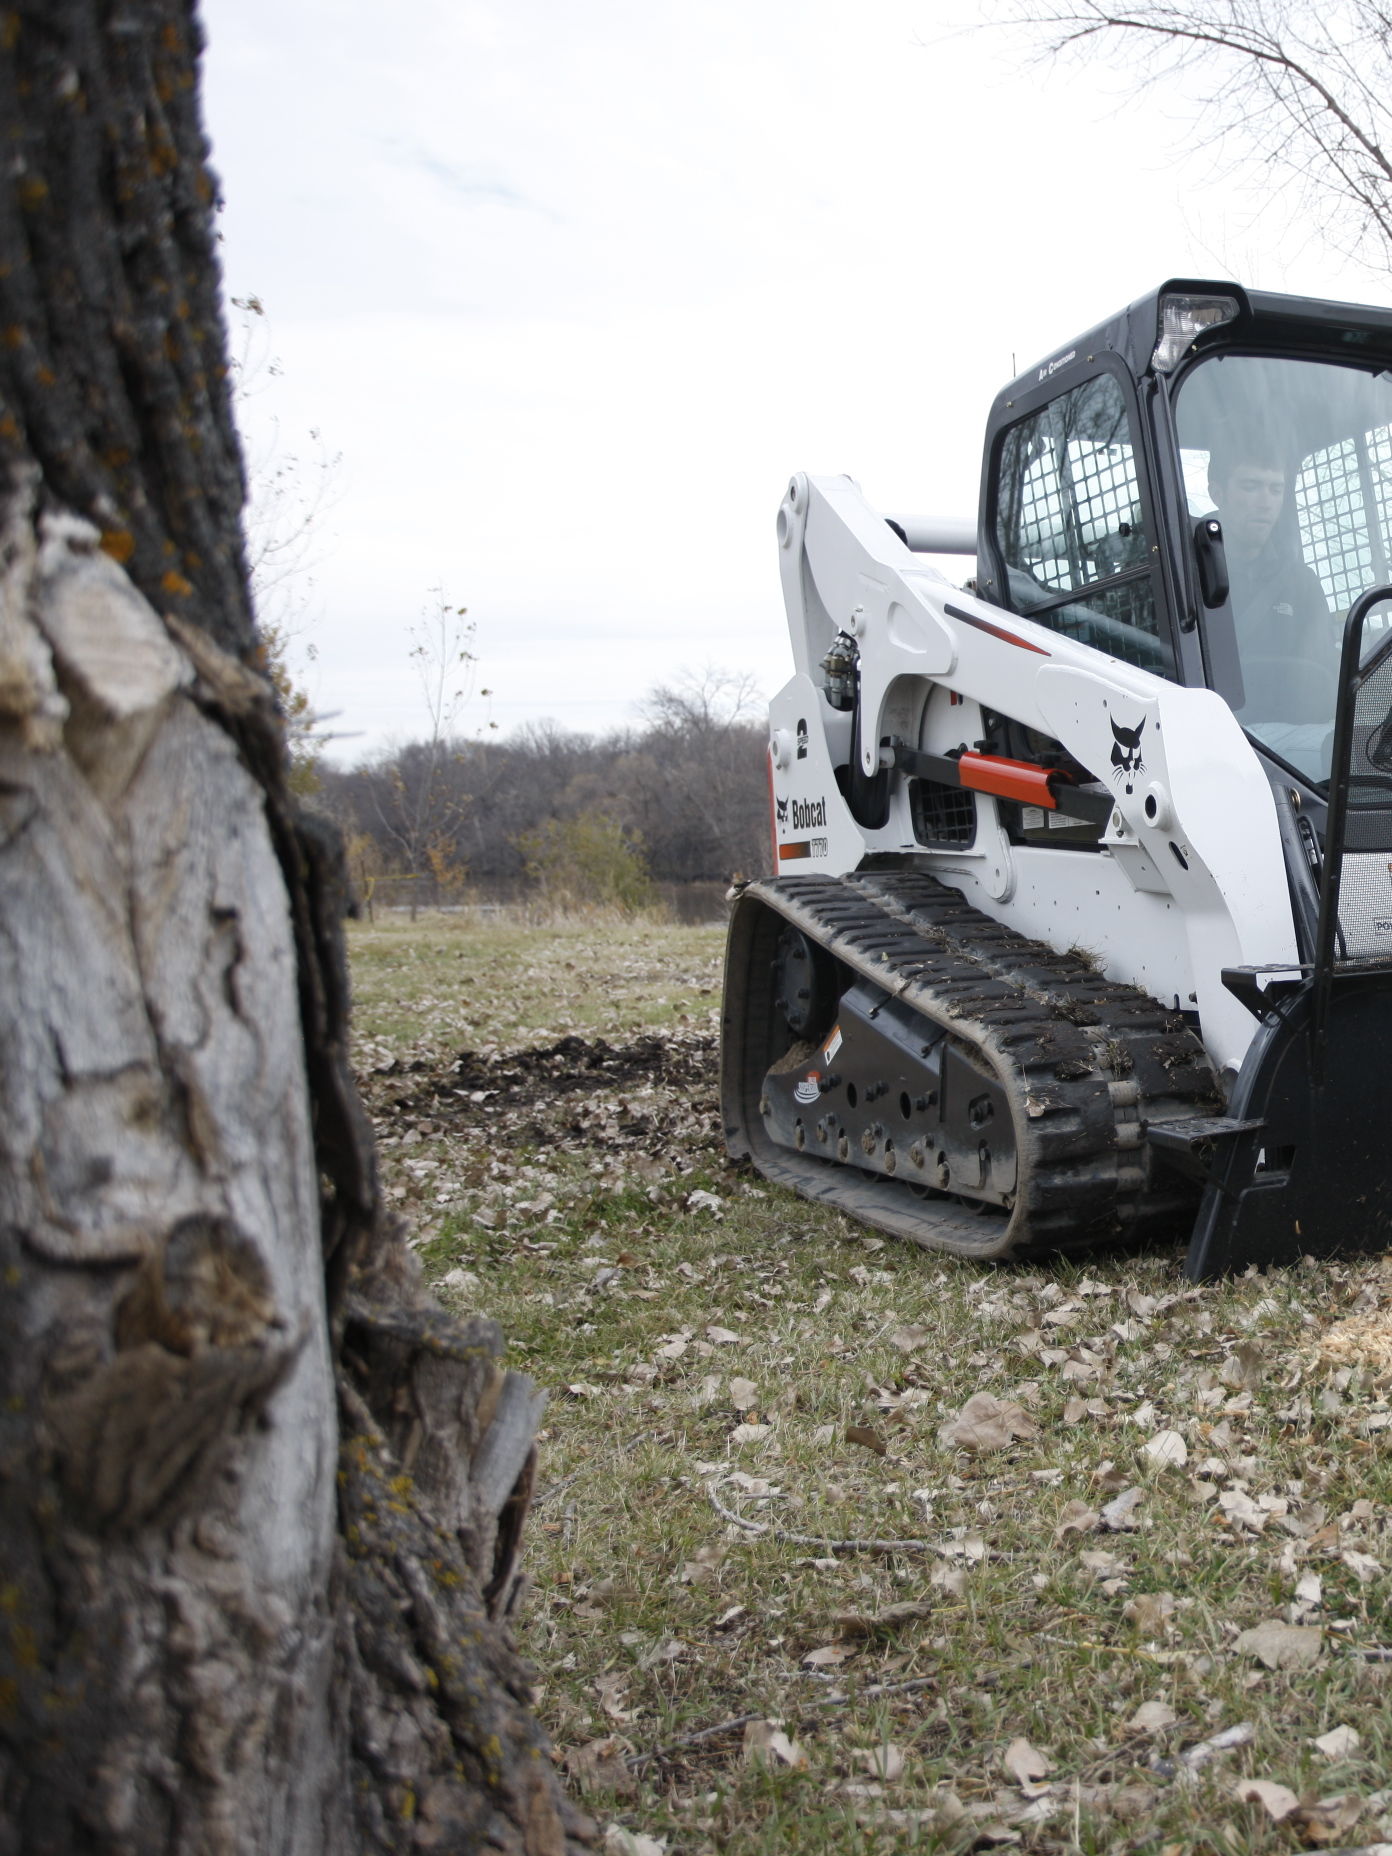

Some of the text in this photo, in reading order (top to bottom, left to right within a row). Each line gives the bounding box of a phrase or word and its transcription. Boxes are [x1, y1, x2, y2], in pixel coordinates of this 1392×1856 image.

[796, 718, 808, 760] 2
[792, 796, 827, 830] Bobcat
[811, 837, 829, 858] T770
